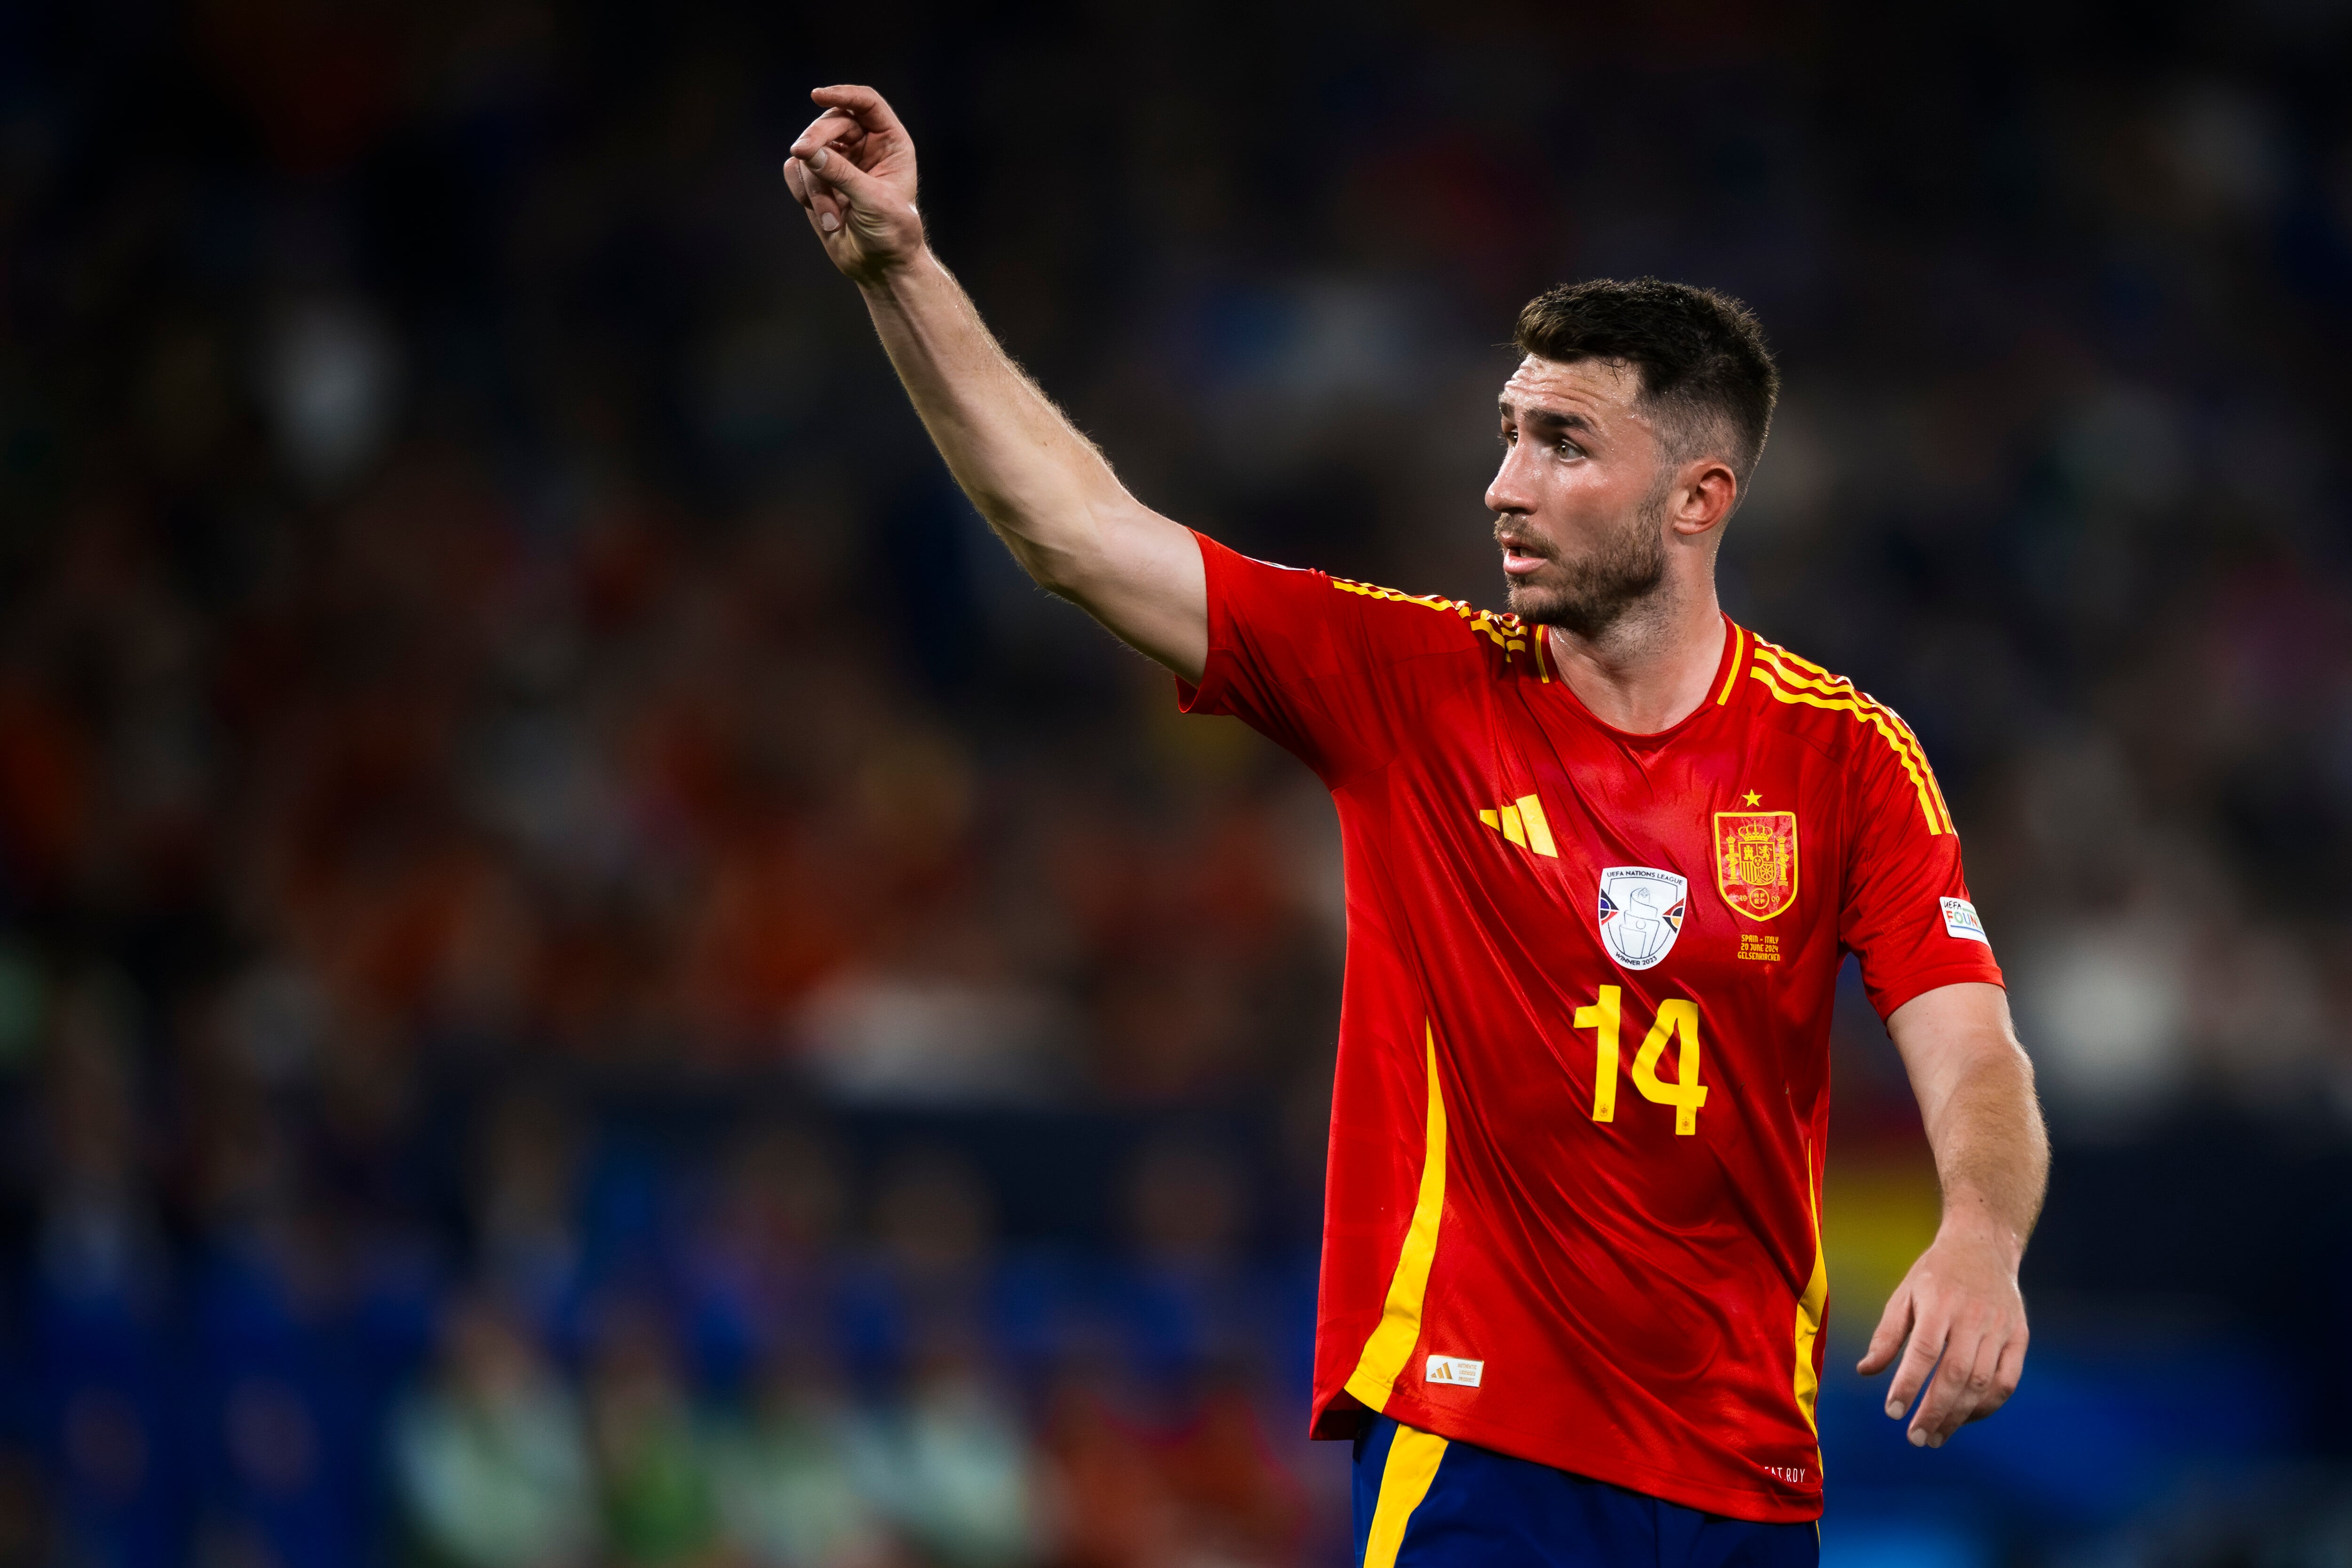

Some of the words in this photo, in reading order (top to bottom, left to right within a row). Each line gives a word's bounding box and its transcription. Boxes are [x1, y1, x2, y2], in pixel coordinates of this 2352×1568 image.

[1657, 873, 1683, 885] LEAGUE
[1944, 900, 1961, 909] UEFA
[1741, 934, 1758, 943] SPAIN
[1750, 943, 1764, 952] JUNE
[1616, 952, 1640, 966] WINNER
[1642, 955, 1657, 965] 2023
[1738, 951, 1780, 961] GELSENKIRCHEN
[1573, 985, 1708, 1135] 14
